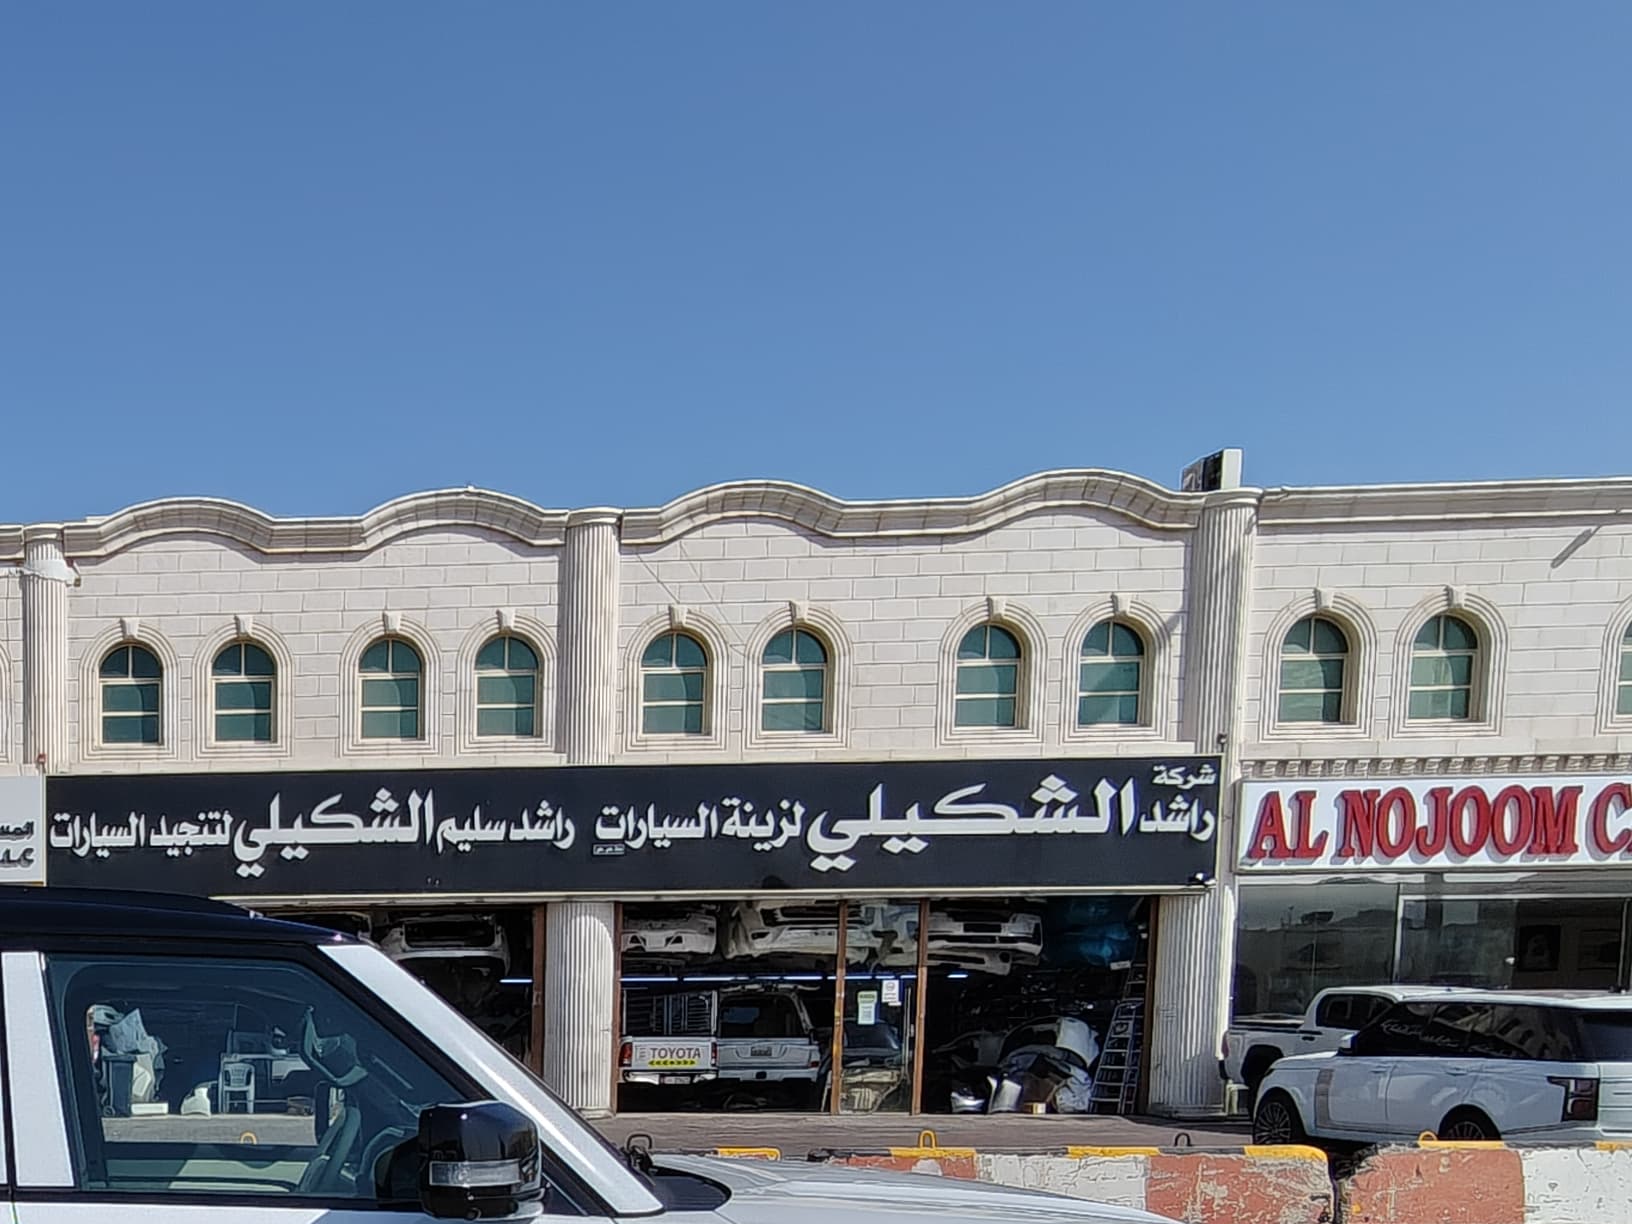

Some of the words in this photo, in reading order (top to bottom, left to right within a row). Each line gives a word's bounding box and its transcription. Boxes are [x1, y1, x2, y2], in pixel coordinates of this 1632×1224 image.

[1152, 764, 1217, 789] شركة
[49, 811, 146, 858] السيارات
[149, 810, 234, 857] لتنجيد
[233, 787, 435, 878] الشكيلي
[435, 804, 507, 854] سليم
[508, 799, 576, 850] راشد
[594, 802, 718, 850] السيارات
[721, 796, 806, 852] لزينة
[805, 773, 1135, 873] الشكيلي
[1139, 794, 1215, 842] راشد
[1242, 789, 1330, 864] AL
[1333, 784, 1584, 864] NOJOOM
[1588, 782, 1632, 857] C
[650, 1047, 701, 1059] TOYOTA
